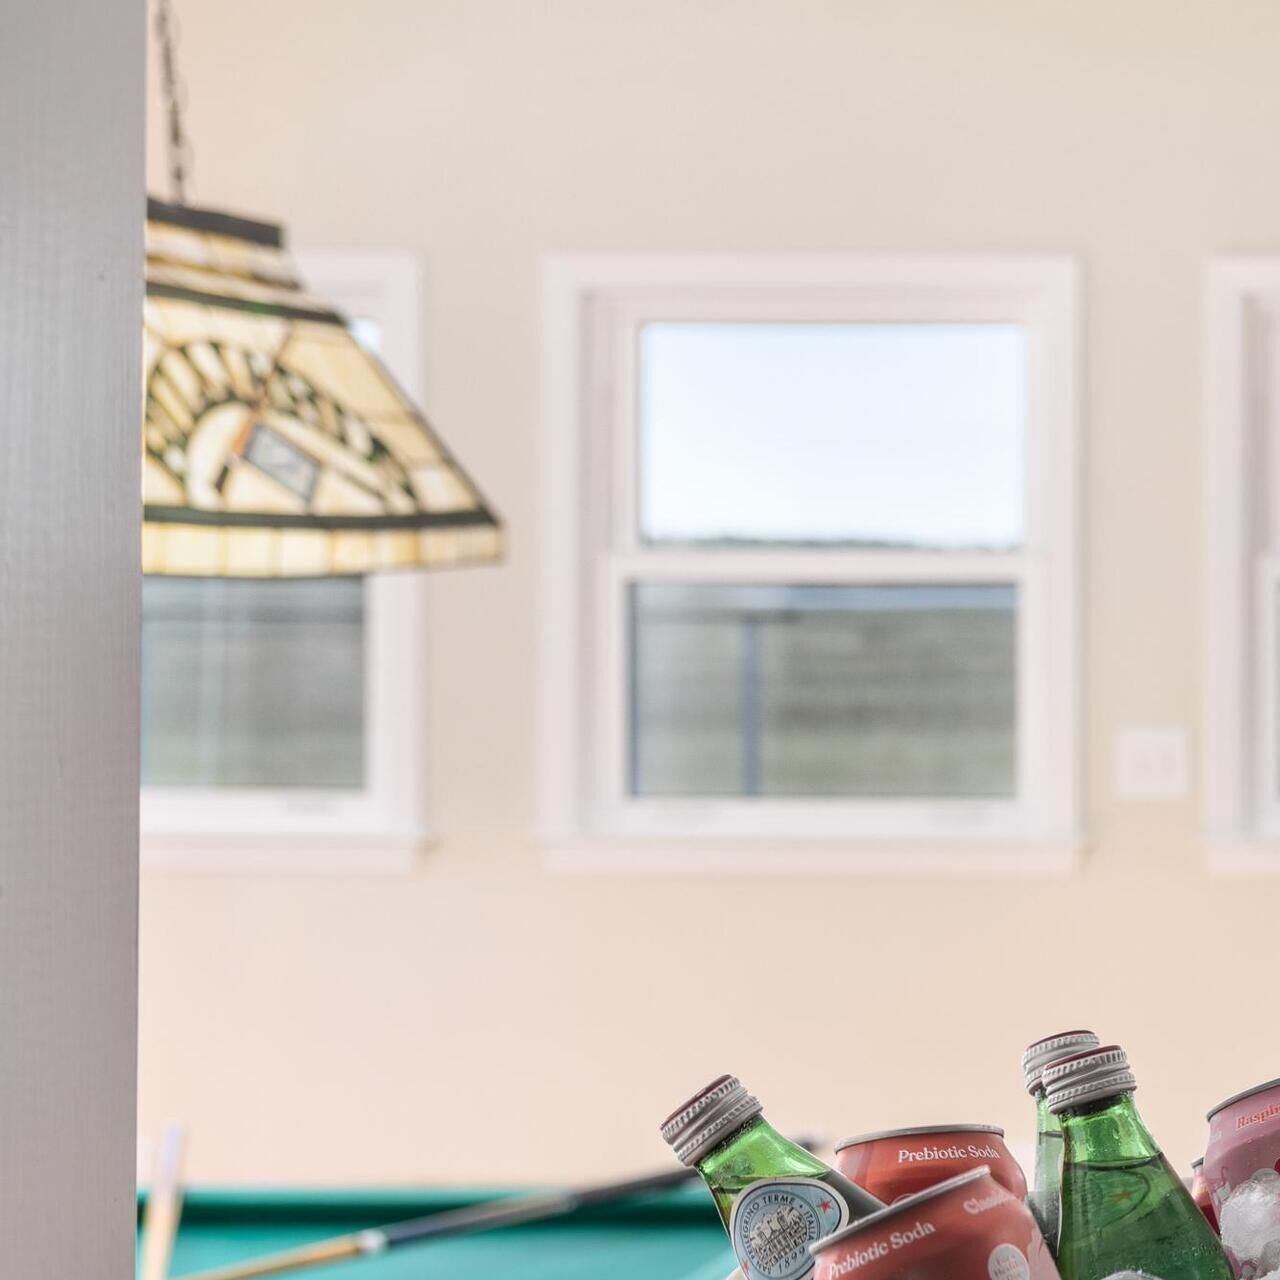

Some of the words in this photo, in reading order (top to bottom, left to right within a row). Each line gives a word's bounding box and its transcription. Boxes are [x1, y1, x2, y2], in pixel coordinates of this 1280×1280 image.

[898, 1145, 968, 1164] Prebiotic
[967, 1144, 1001, 1159] Soda
[762, 1193, 796, 1206] TERME
[889, 1220, 937, 1249] Soda
